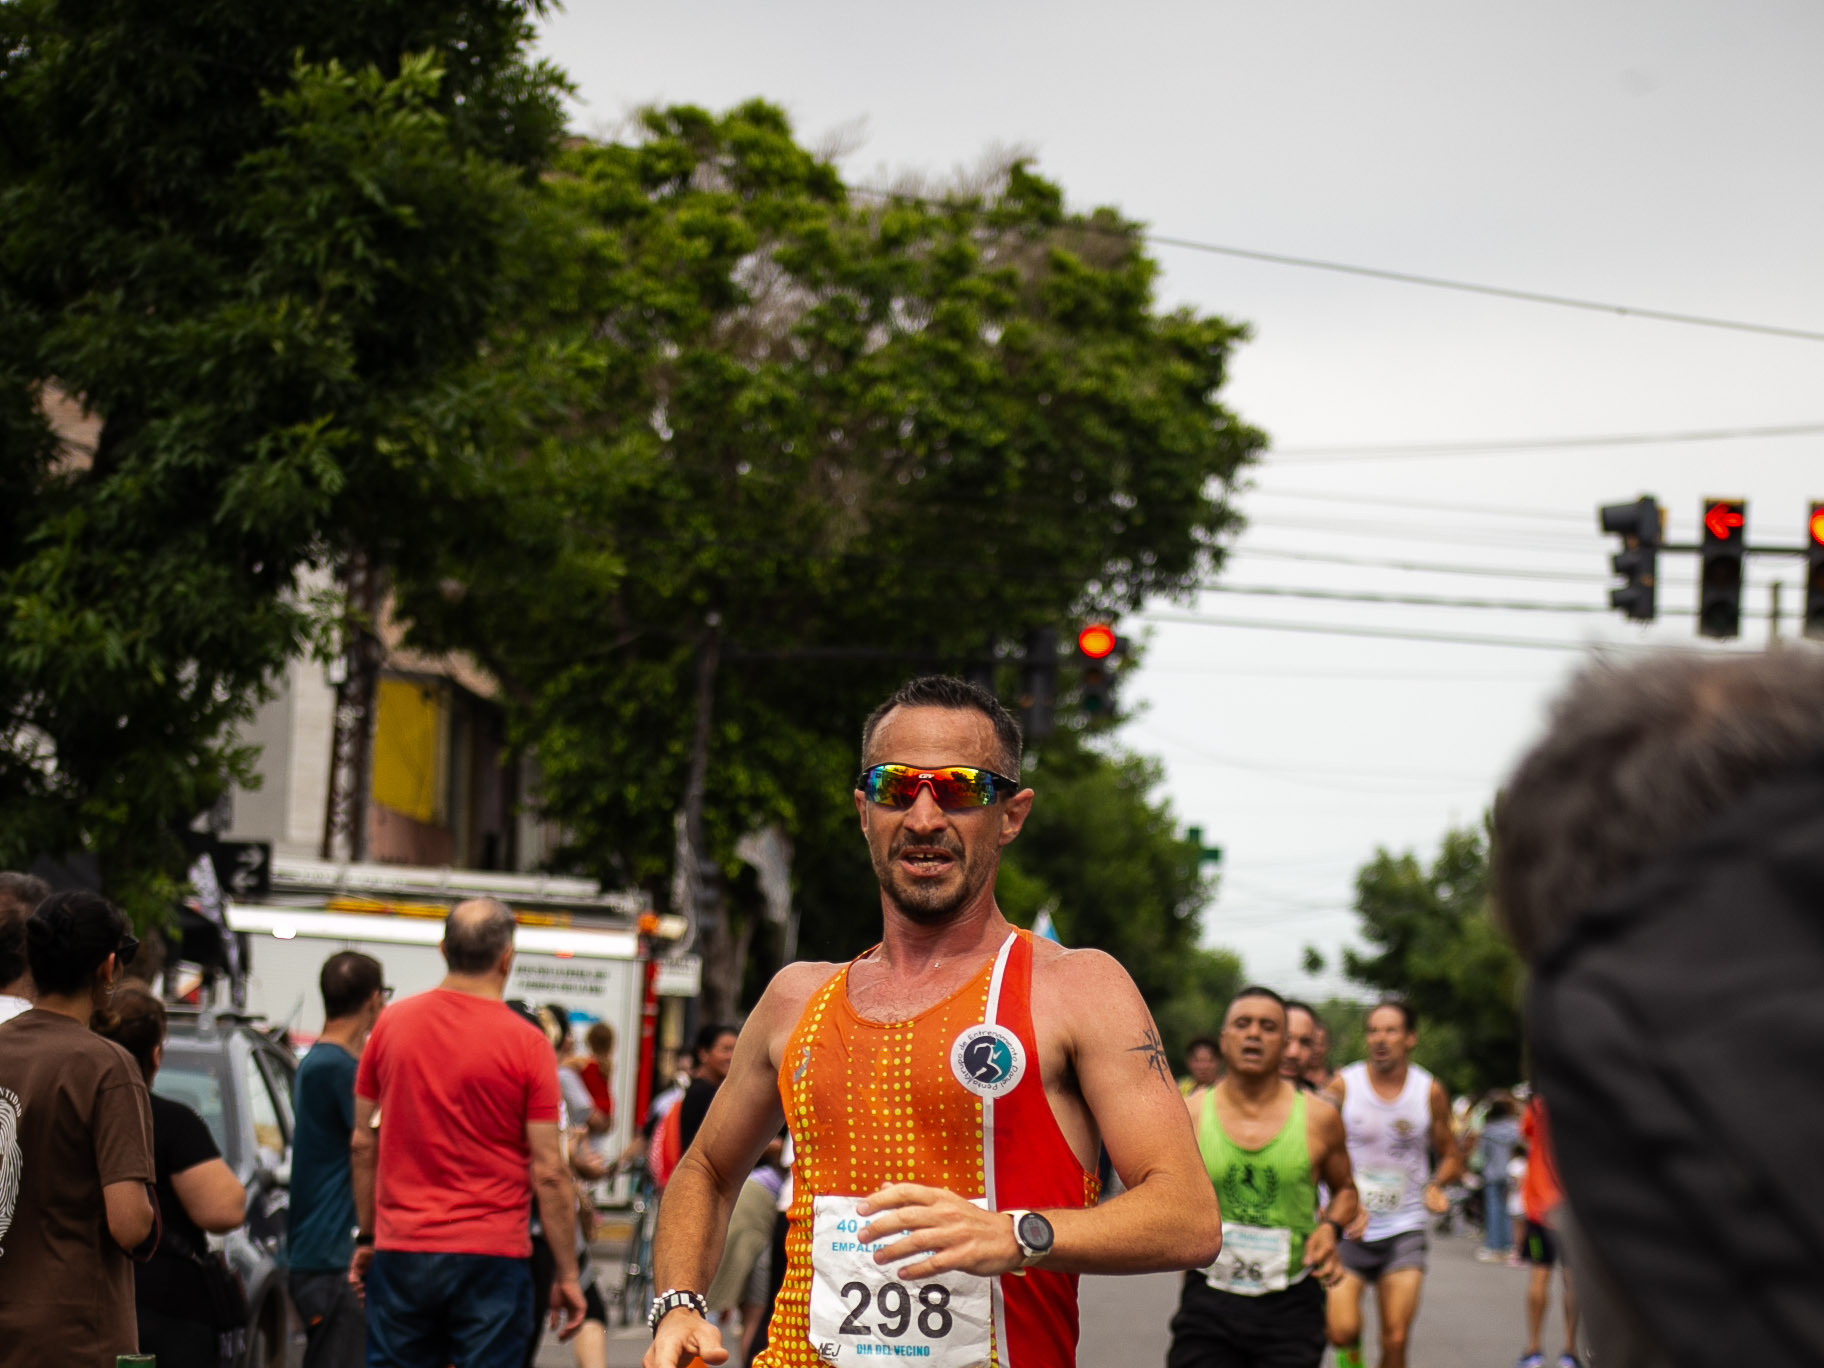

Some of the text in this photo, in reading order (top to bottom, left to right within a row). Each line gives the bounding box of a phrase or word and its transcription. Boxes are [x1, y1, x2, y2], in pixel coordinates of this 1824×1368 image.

[836, 1220, 857, 1233] 40
[832, 1242, 888, 1253] EMPALM
[839, 1281, 953, 1339] 298
[856, 1344, 931, 1357] DIA DEL VECINO
